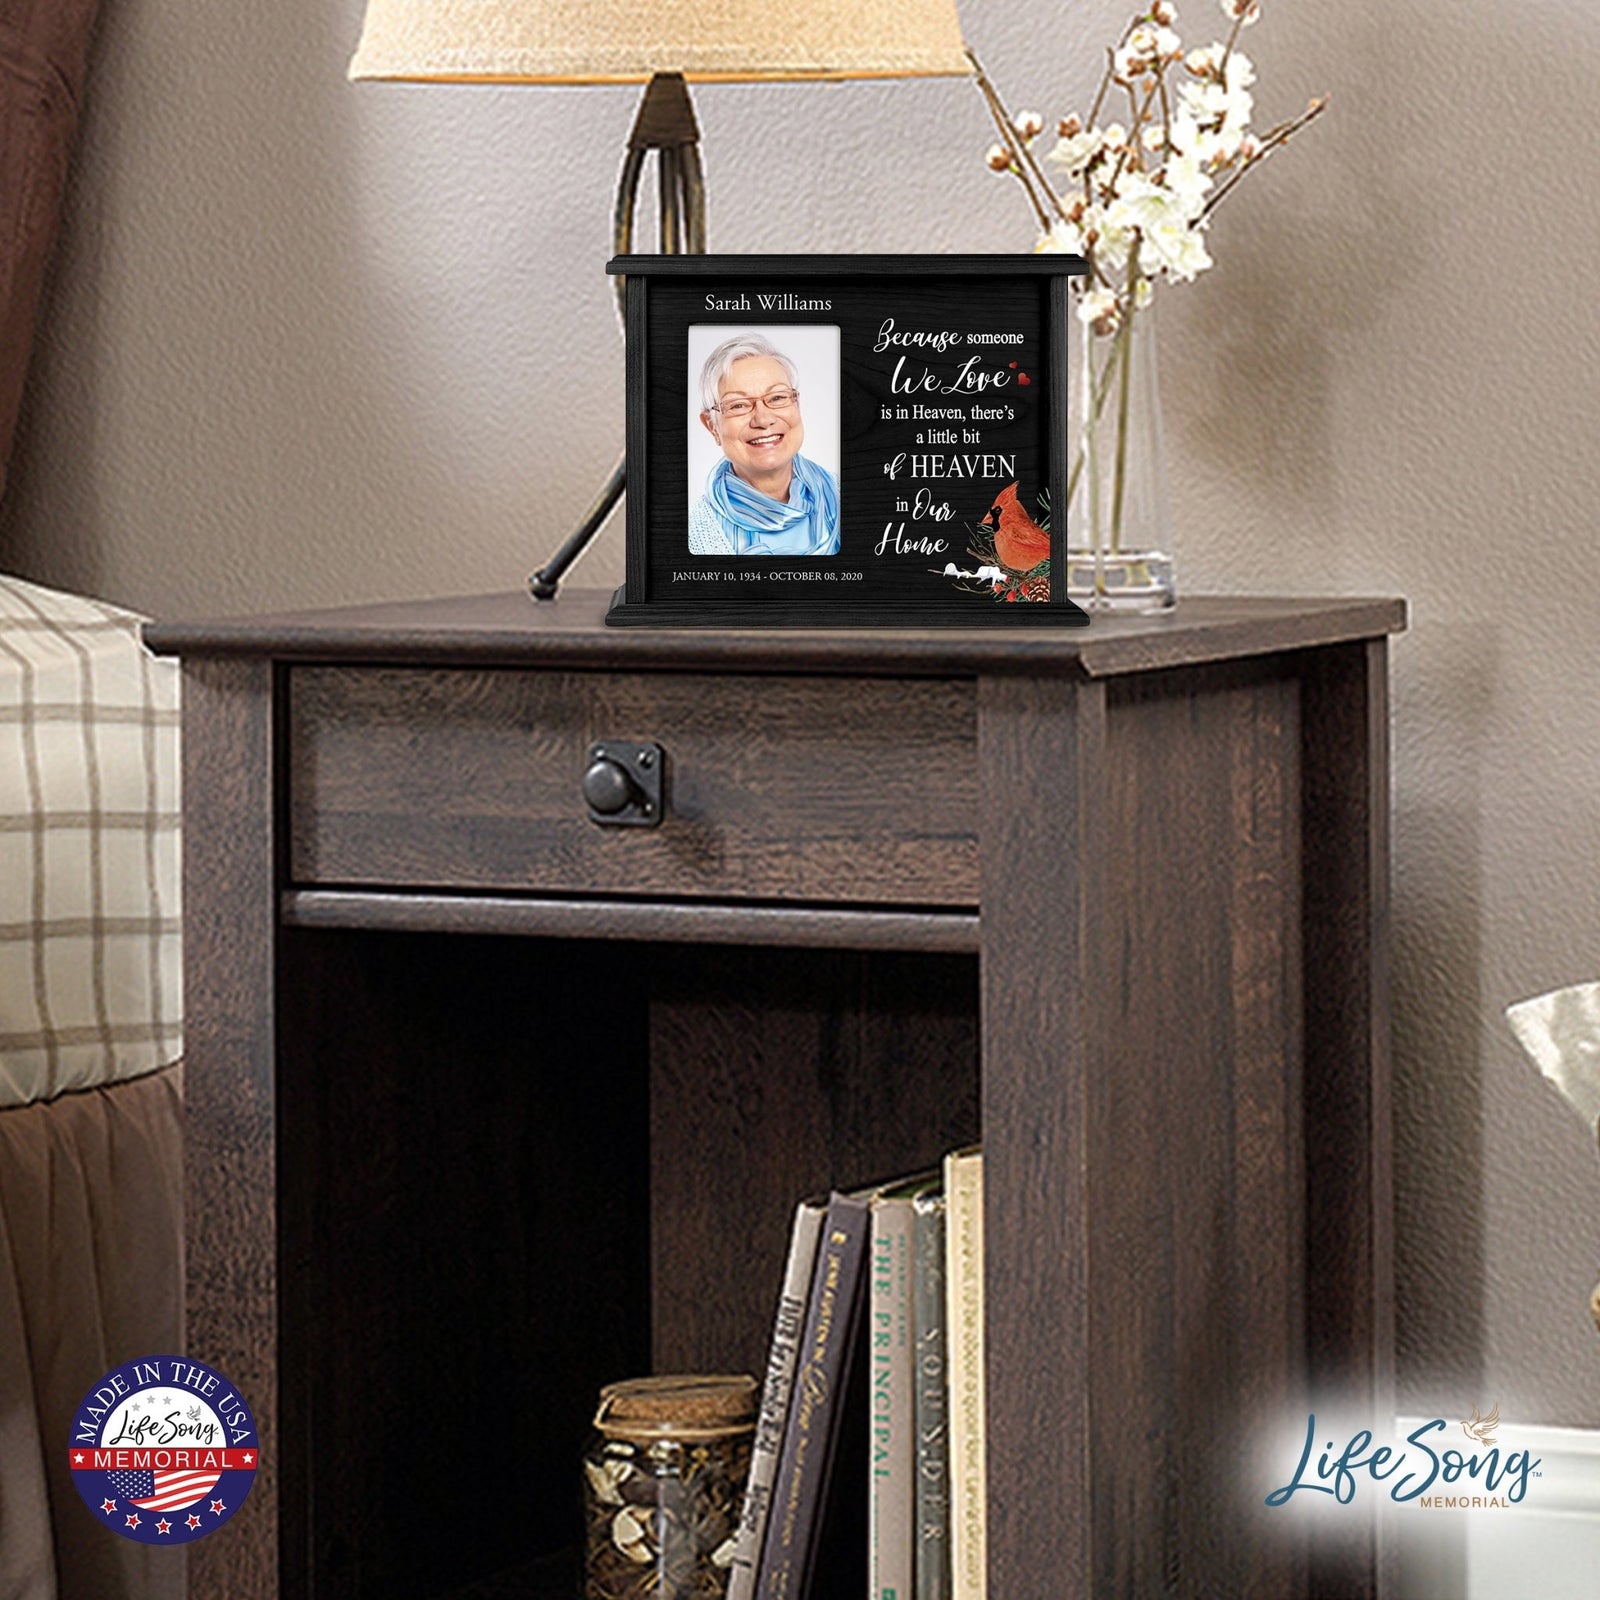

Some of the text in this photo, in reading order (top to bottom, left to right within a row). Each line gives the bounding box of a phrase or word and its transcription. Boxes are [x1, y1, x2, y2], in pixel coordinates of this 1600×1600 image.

[704, 293, 832, 311] Sarah Williams
[873, 318, 1024, 353] Because someone
[891, 355, 1011, 395] We Love
[880, 404, 1015, 422] is in Heaven, there's
[916, 428, 981, 444] a little bit
[883, 452, 1016, 481] of HEAVEN
[895, 487, 956, 522] in Our
[874, 522, 949, 556] Home
[672, 571, 721, 583] JANUARY
[723, 571, 737, 582] 10,
[739, 571, 762, 582] 1934
[769, 571, 822, 582] OCTOBER
[823, 571, 839, 582] 08,
[840, 571, 863, 582] 2020
[874, 1235, 892, 1481] THE PRINCIPAL
[921, 1327, 945, 1540] SOUNDER
